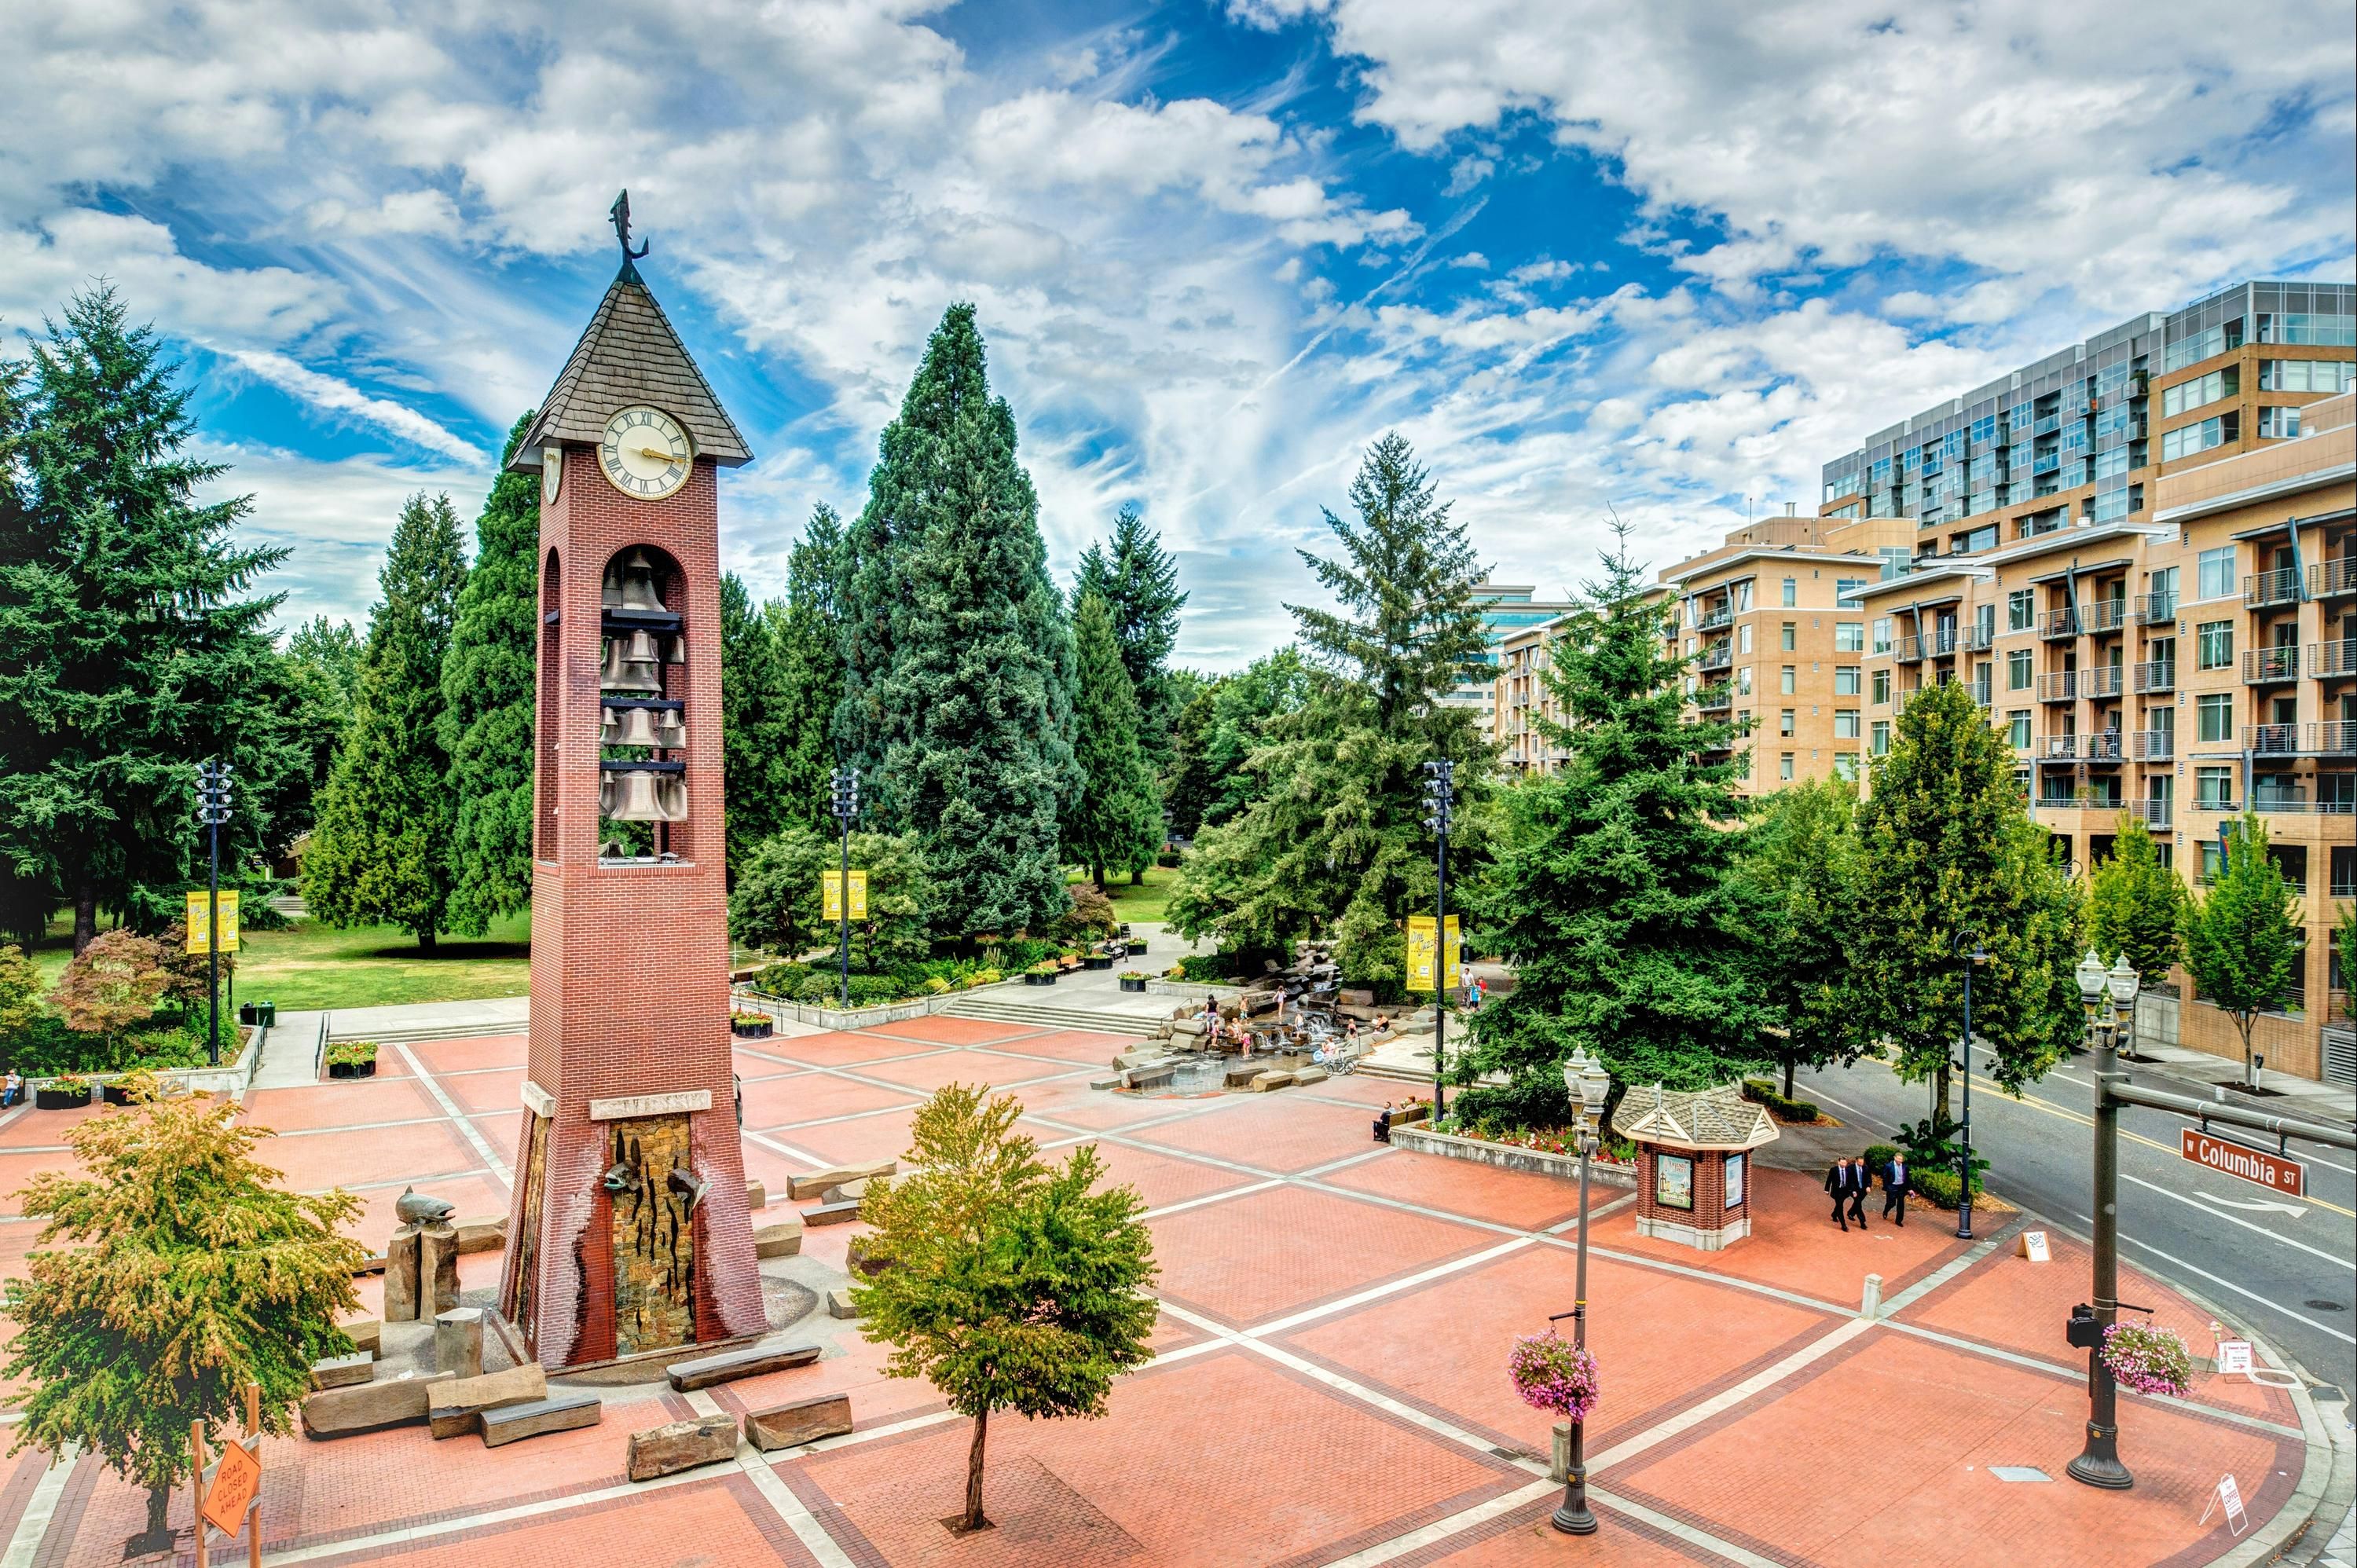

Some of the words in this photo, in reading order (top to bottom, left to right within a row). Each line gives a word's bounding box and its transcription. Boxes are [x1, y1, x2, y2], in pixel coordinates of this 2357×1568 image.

[2187, 1138, 2194, 1152] W
[2199, 1139, 2275, 1185] Columbia
[2284, 1171, 2296, 1185] ST
[222, 1460, 243, 1483] ROAD
[218, 1472, 247, 1501] CLOSED
[2223, 1489, 2238, 1504] COFFEE
[220, 1488, 247, 1517] AHEAD
